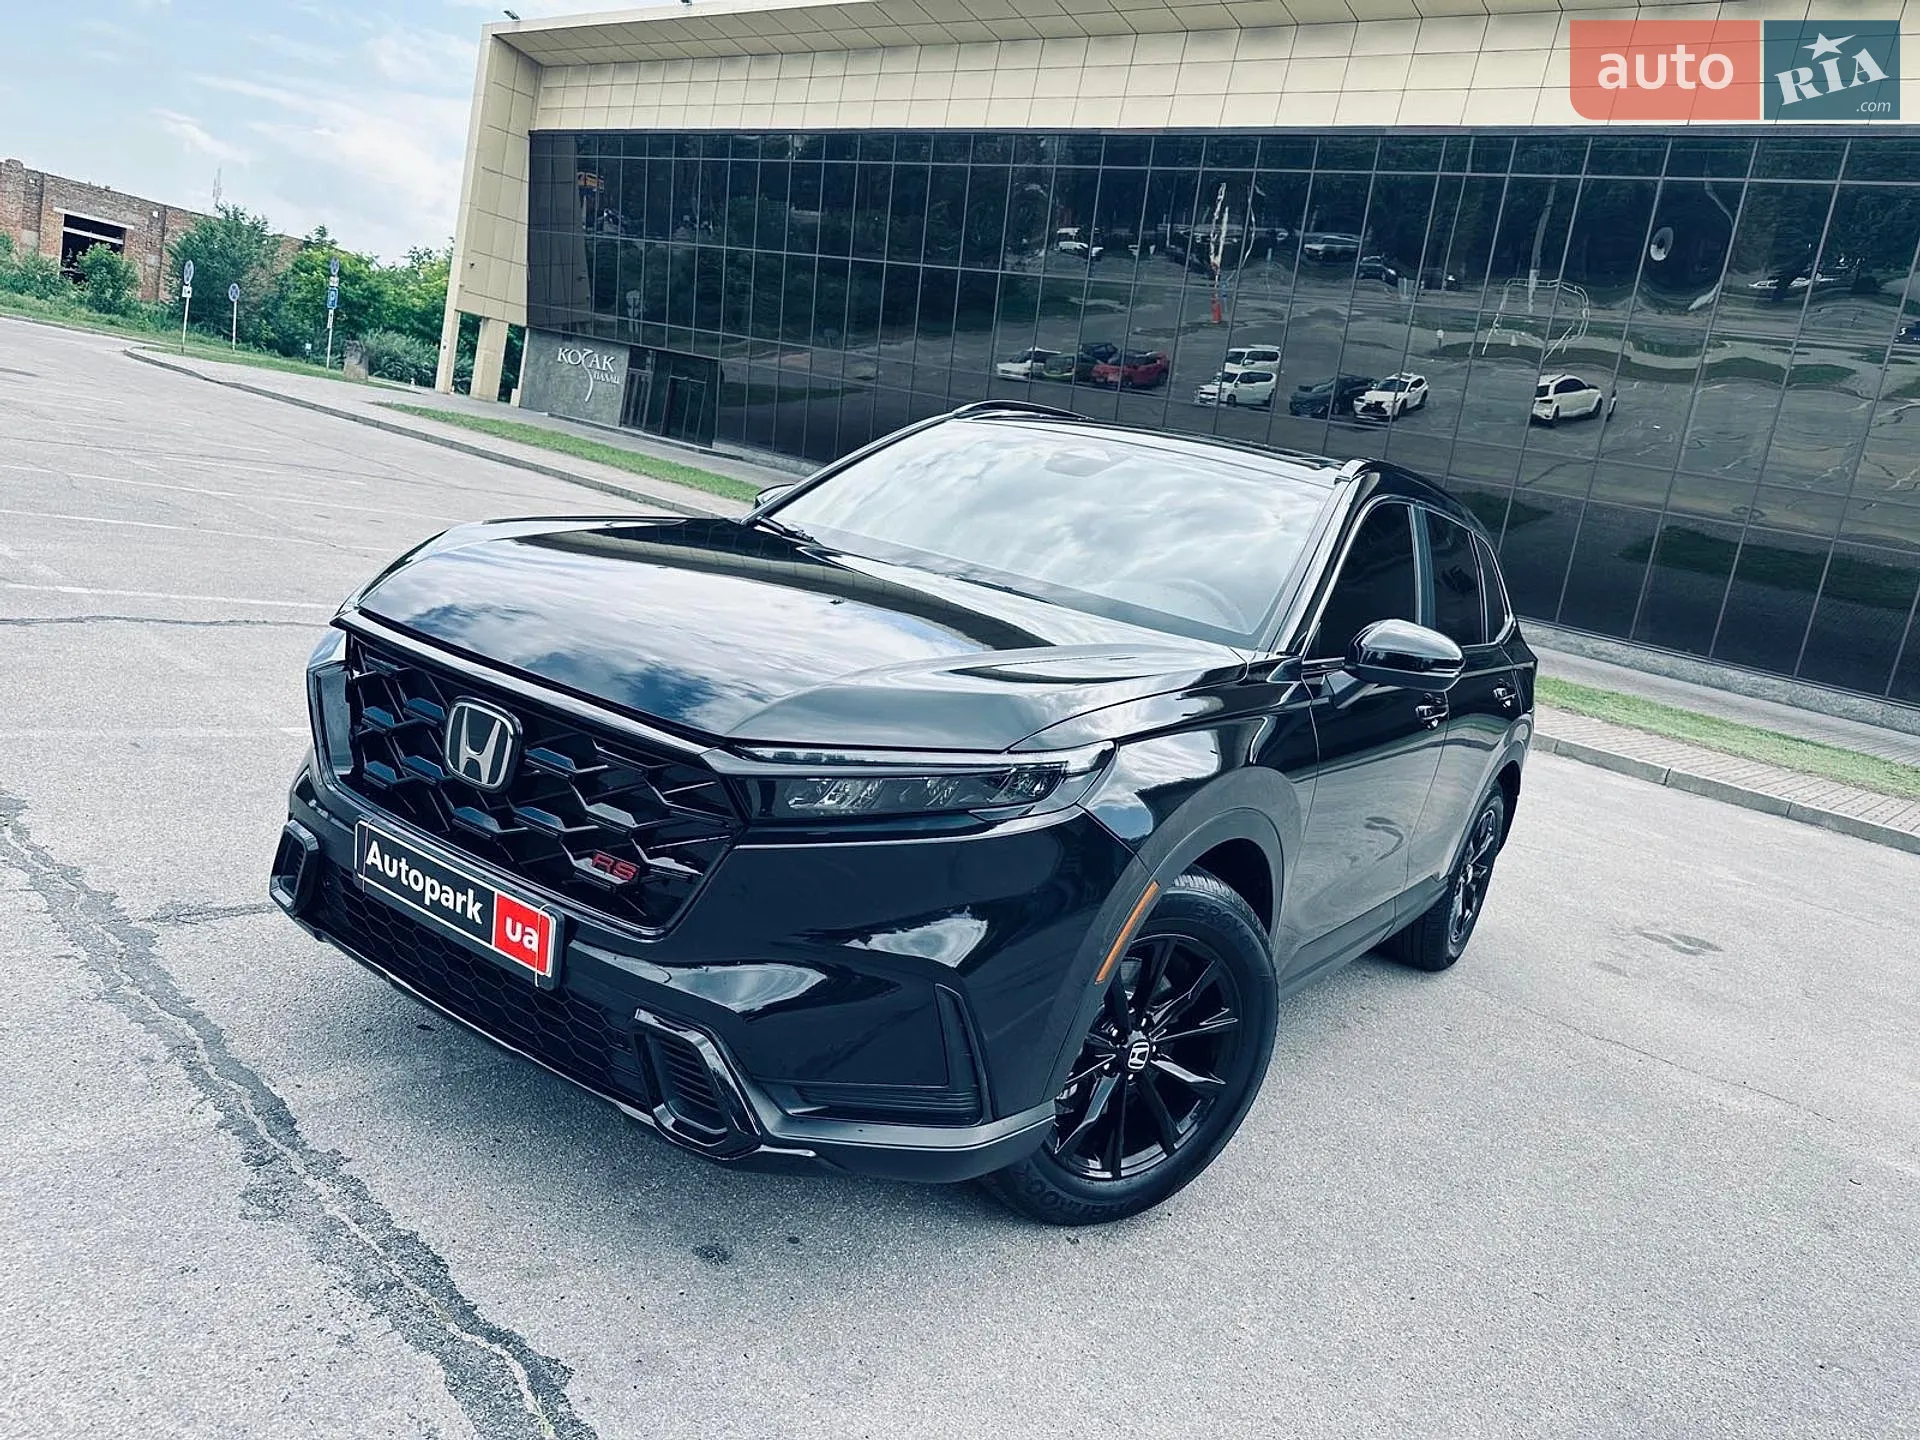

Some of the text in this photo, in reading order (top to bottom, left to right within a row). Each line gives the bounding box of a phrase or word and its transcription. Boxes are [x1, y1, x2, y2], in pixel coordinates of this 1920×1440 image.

[366, 840, 538, 952] Autopark ua
[592, 853, 637, 881] RS
